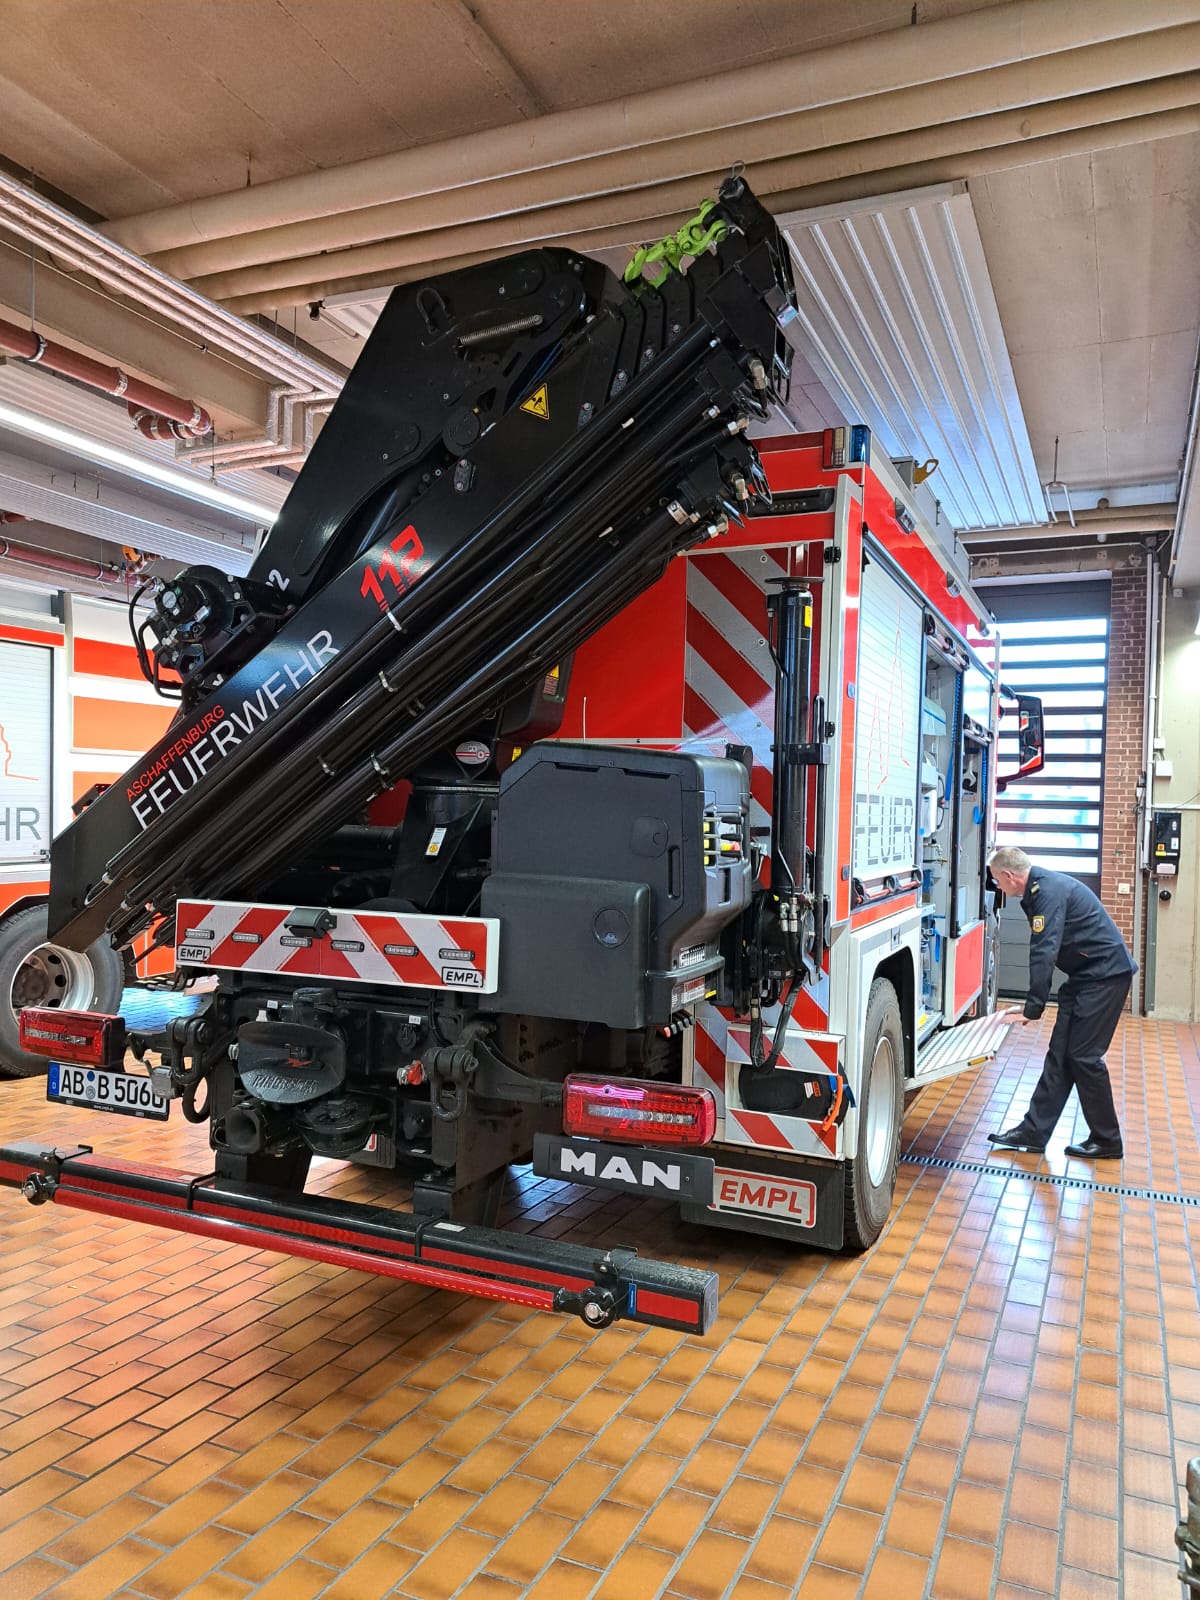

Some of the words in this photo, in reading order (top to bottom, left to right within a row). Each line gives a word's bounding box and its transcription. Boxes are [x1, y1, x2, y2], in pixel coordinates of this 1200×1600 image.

[360, 524, 434, 612] 112
[126, 704, 225, 802] ASCHAFFENBURG
[855, 793, 913, 868] FEUER
[180, 948, 208, 959] EMPL
[446, 971, 479, 984] EMPL
[61, 1069, 84, 1095] AB
[97, 1074, 110, 1099] B
[560, 1147, 681, 1191] MAN
[719, 1179, 802, 1214] EMPL
